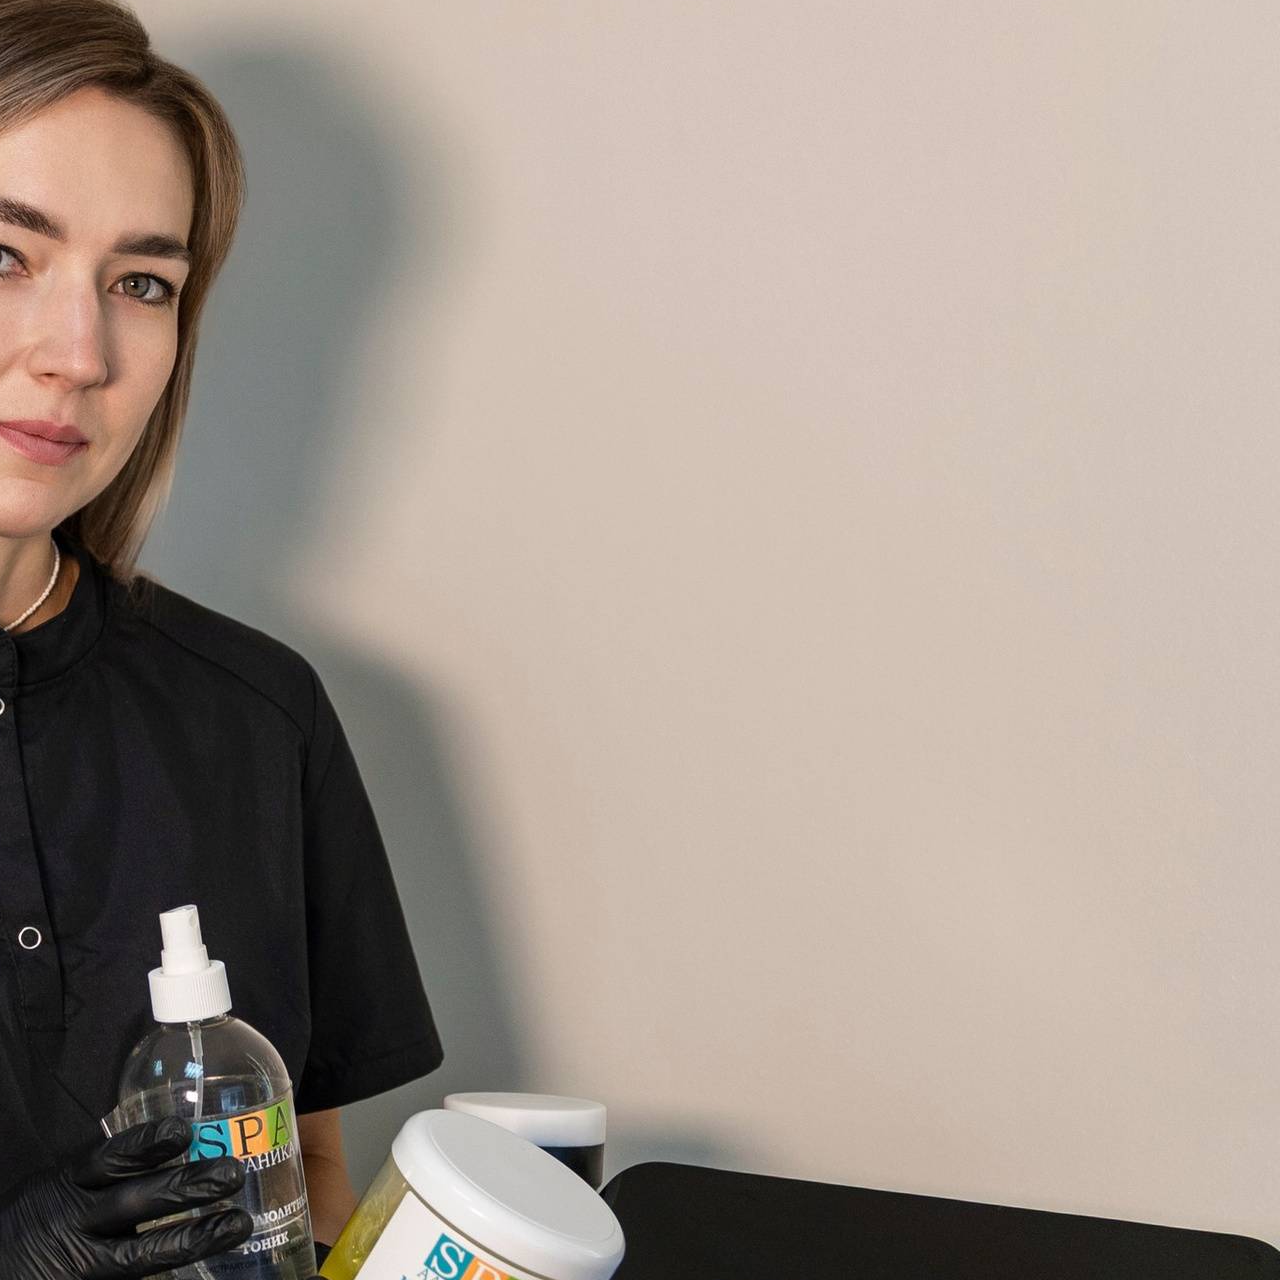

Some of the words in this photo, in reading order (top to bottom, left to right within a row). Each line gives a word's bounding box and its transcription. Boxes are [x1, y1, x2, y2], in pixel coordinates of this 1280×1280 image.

[197, 1105, 292, 1159] SPA
[244, 1141, 296, 1173] АНИКА
[242, 1231, 290, 1255] ТОНИК
